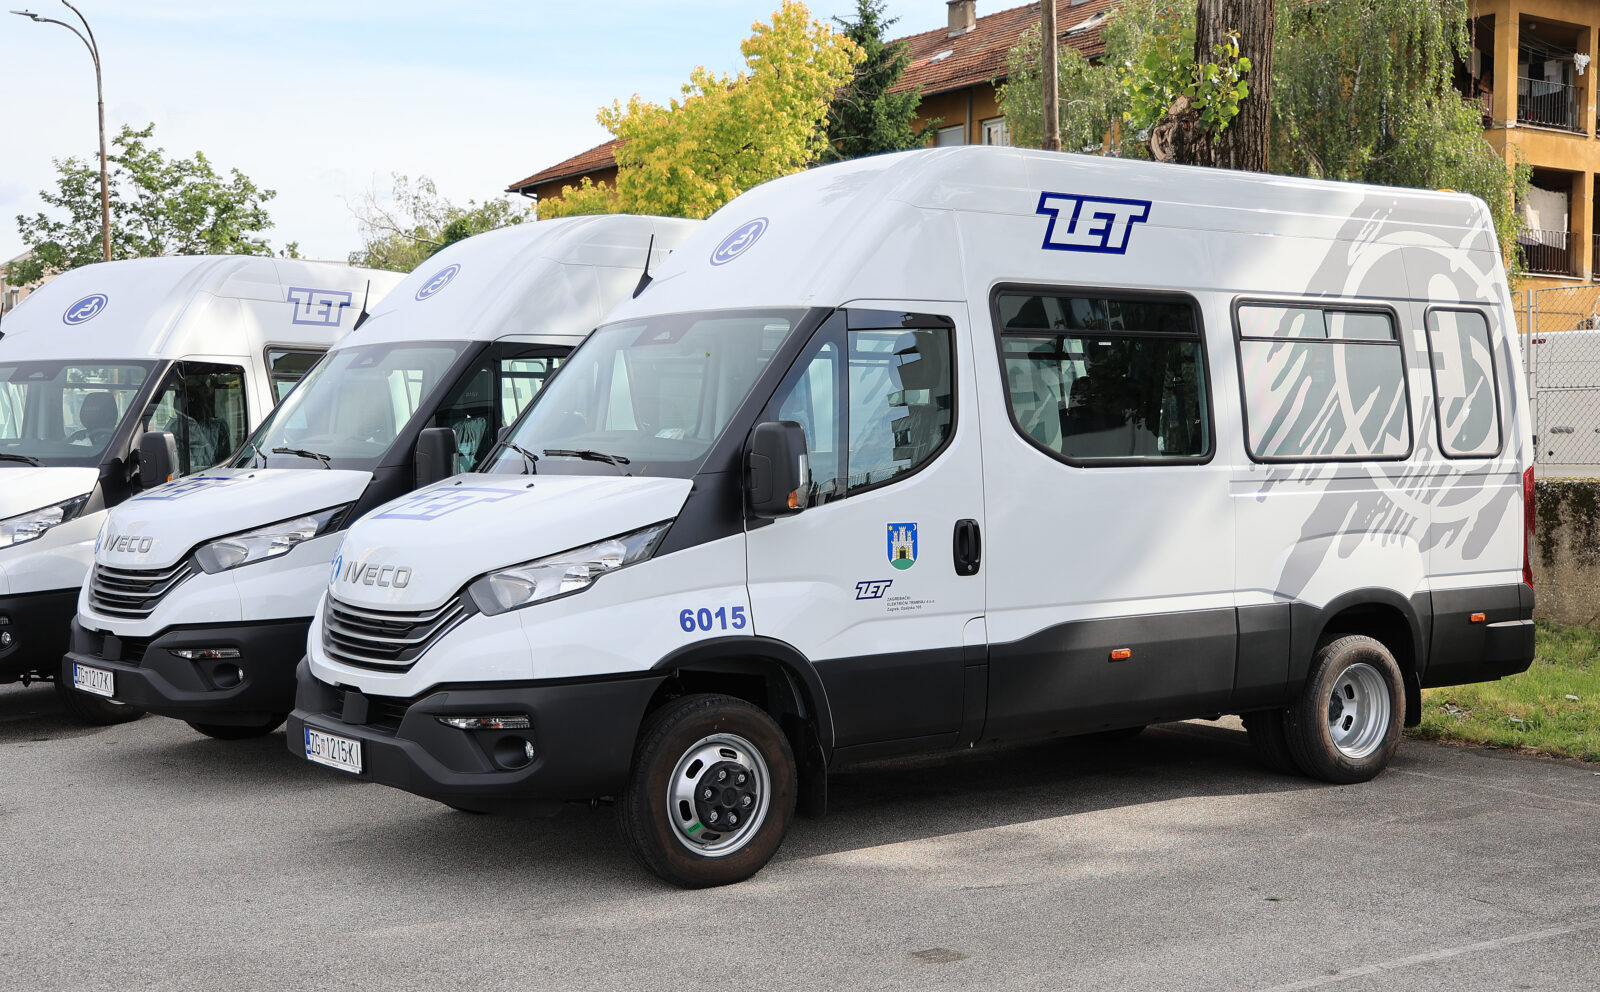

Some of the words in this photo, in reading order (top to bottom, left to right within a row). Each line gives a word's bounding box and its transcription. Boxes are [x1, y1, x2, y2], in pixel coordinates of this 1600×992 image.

[1036, 191, 1152, 255] ZET
[287, 286, 353, 327] ZET
[103, 534, 154, 554] IVECO
[343, 560, 412, 589] IVECO
[855, 580, 893, 600] ZET
[680, 606, 746, 632] 6015
[78, 667, 85, 683] ZG
[310, 732, 321, 755] ZG
